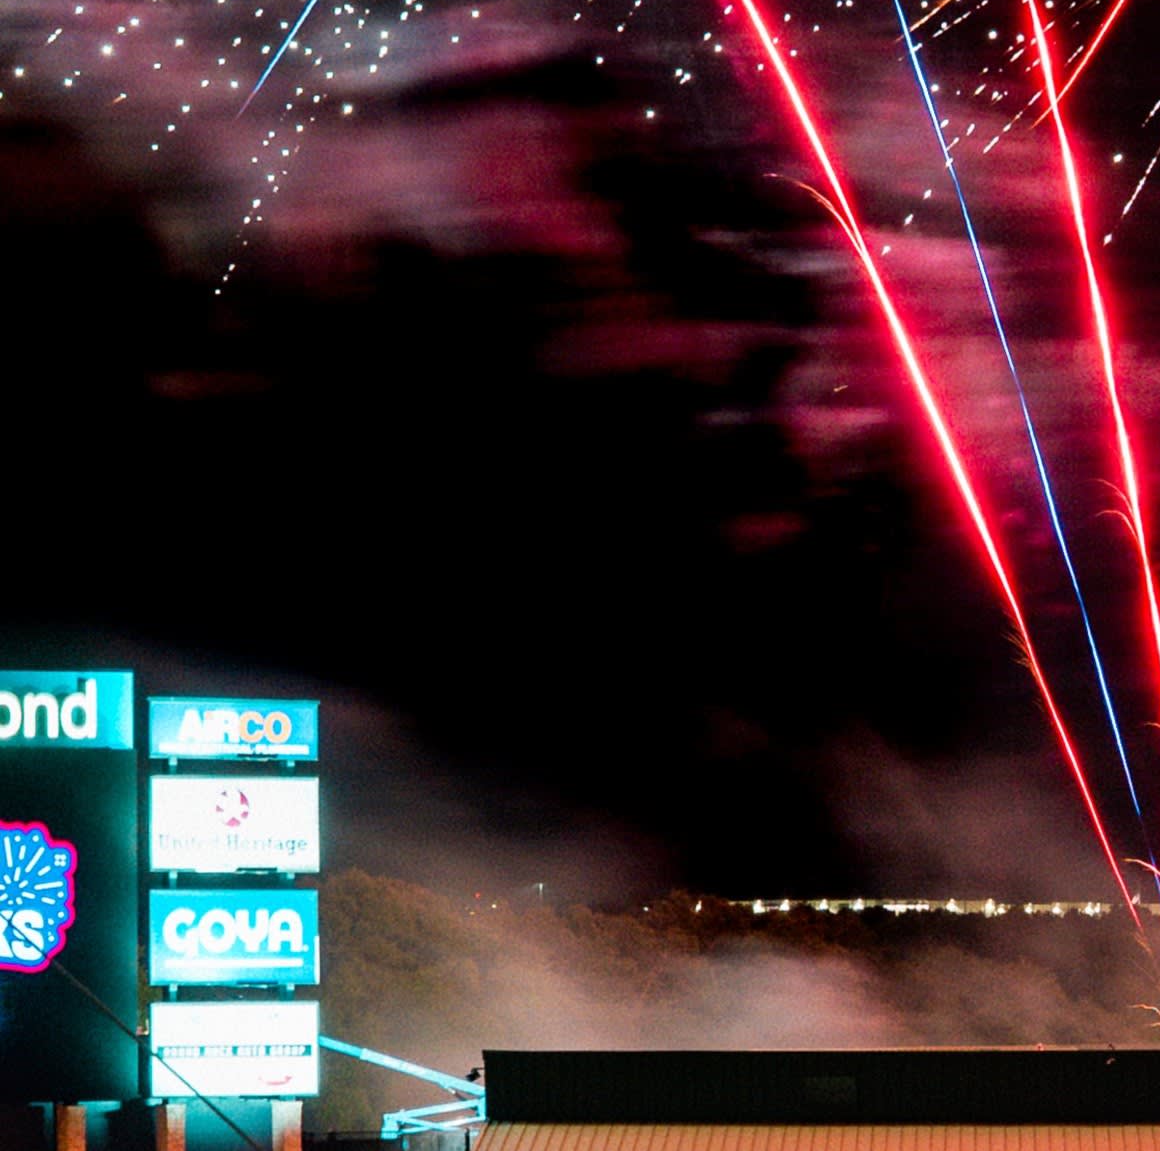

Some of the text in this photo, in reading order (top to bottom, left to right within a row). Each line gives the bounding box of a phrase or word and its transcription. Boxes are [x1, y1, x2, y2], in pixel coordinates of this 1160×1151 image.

[0, 678, 97, 740] ond
[178, 709, 292, 744] AIRCO
[159, 834, 220, 849] Unitd
